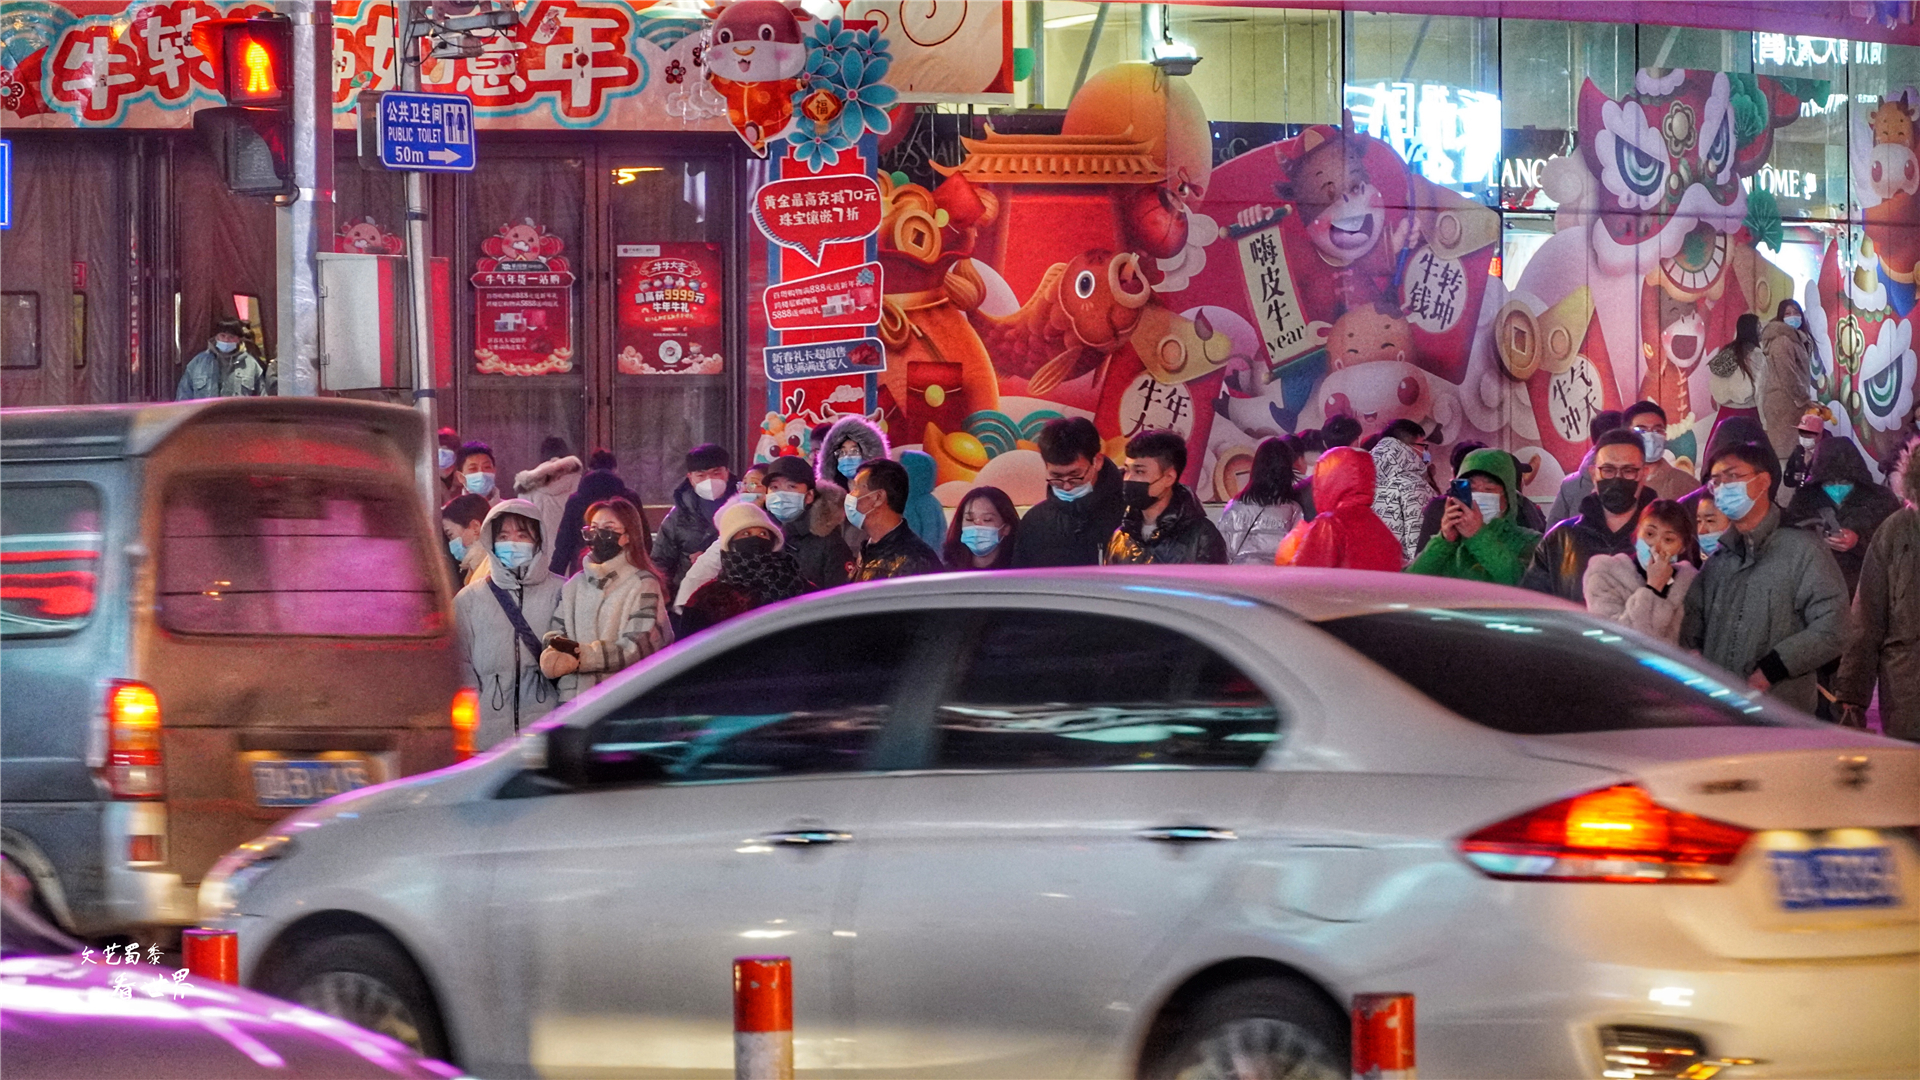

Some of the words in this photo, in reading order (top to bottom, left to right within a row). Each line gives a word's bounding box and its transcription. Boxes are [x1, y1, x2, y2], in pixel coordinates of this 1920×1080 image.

[62, 6, 628, 110] 牛转如意年
[387, 101, 443, 125] 公共卫生间
[816, 100, 829, 115] 福
[388, 126, 414, 142] PUBLIC
[417, 128, 441, 143] TOILET
[395, 146, 424, 163] 50m
[764, 188, 877, 210] 黄金最高克减70元
[779, 207, 859, 226] 珠宝镶嵌7折
[485, 274, 560, 286] 牛气年货一站购
[1250, 233, 1291, 331] 嗨皮牛
[652, 302, 690, 313] 牛年牛礼
[1266, 324, 1305, 359] year
[771, 346, 847, 364] 新春礼卡超值售
[773, 359, 848, 375] 实惠满满送家人
